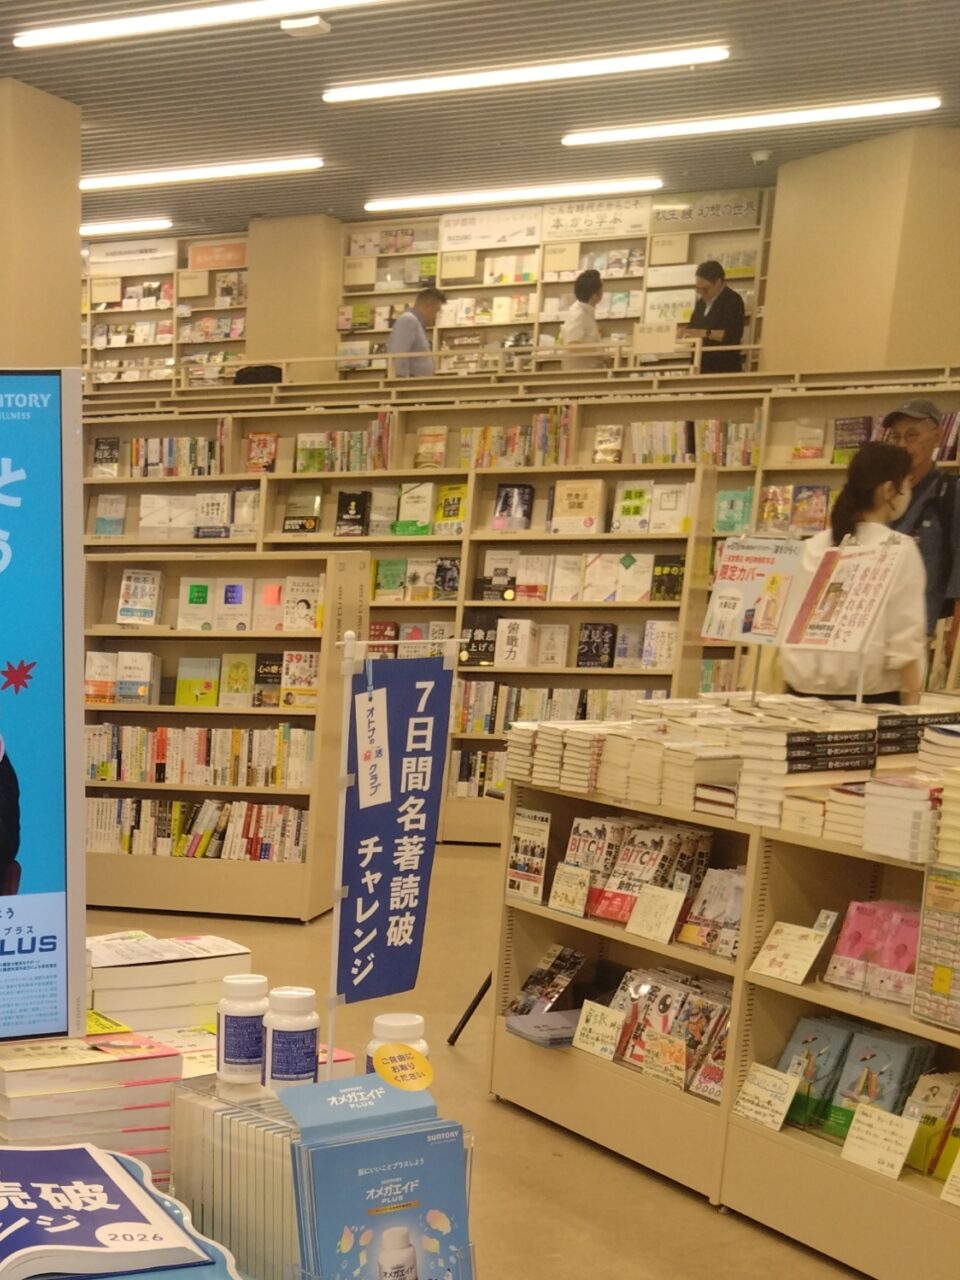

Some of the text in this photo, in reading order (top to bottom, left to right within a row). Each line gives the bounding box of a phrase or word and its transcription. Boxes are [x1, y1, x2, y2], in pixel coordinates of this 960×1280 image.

[386, 681, 435, 947] 7日間名著読破
[569, 837, 605, 857] BITCH
[620, 847, 661, 867] BITCH
[351, 836, 383, 987] チャレンジ
[394, 1070, 427, 1083] ください
[327, 1087, 387, 1107] オメガエイド
[366, 1179, 420, 1201] オメガエイド
[107, 1231, 164, 1243] 2026
